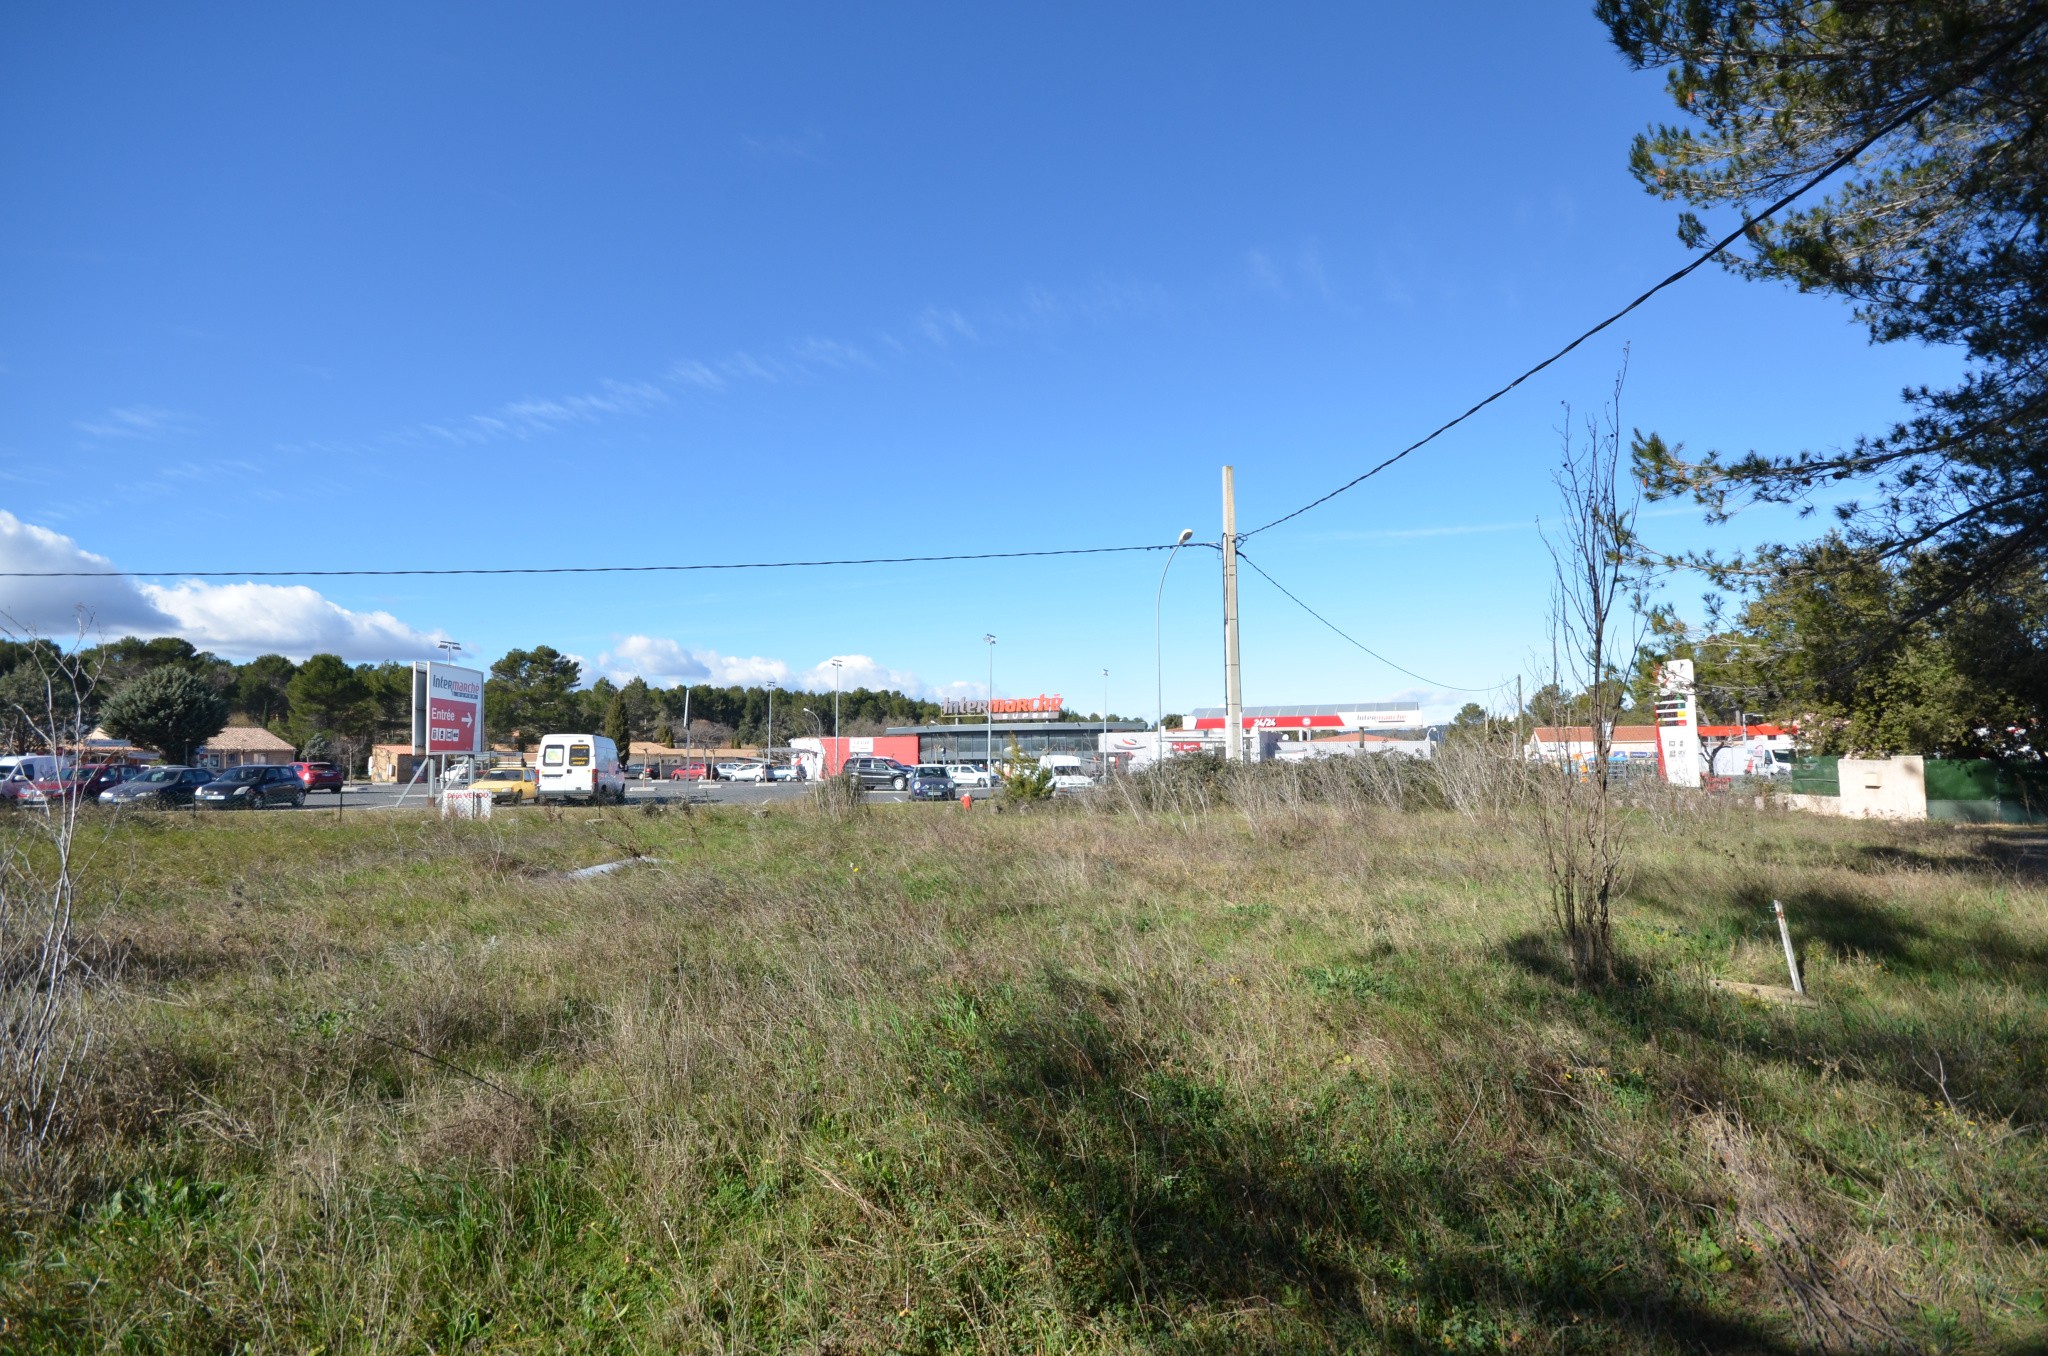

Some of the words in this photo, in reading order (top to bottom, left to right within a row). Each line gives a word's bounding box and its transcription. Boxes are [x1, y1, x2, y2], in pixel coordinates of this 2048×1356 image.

[433, 675, 480, 694] Intermarché
[943, 694, 1063, 714] Intermarché
[431, 707, 455, 721] Entrée
[1254, 718, 1276, 727] 24/24
